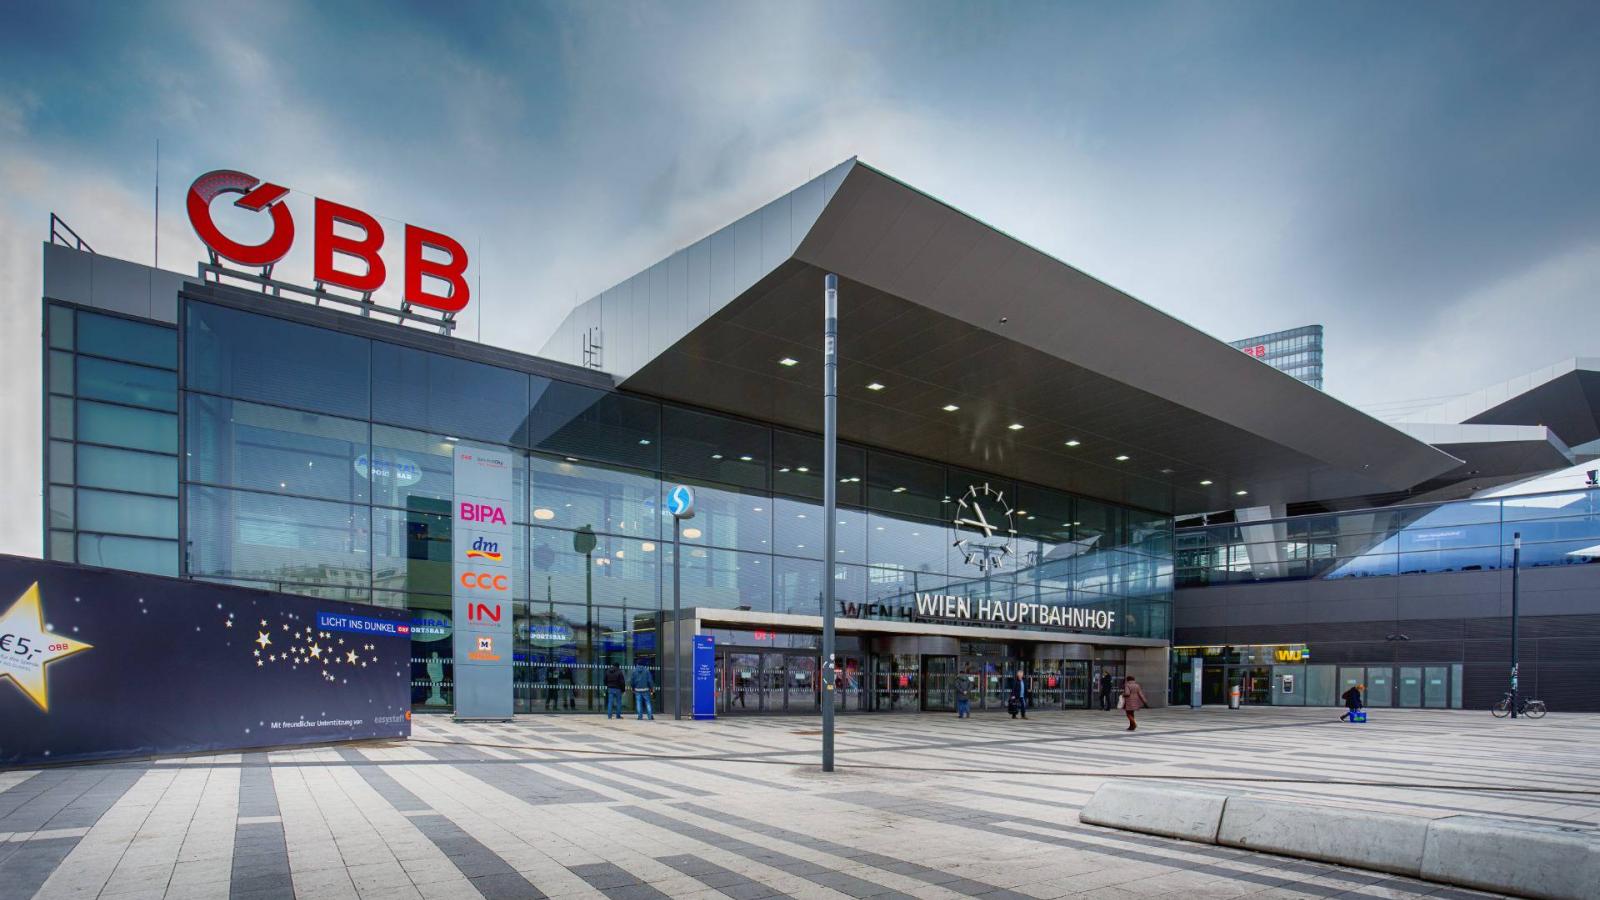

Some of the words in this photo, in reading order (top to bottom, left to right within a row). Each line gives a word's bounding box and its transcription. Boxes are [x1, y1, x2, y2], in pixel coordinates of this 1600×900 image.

[460, 502, 507, 526] BIPA
[473, 536, 499, 553] dm
[461, 572, 508, 591] CCC
[468, 602, 501, 622] IN
[915, 592, 971, 619] WIEN
[978, 599, 1115, 630] HAUPTBAHNHOF
[321, 616, 347, 627] LICHT
[349, 619, 363, 629] INS
[365, 621, 396, 633] DUNKEL
[270, 721, 282, 729] Mit
